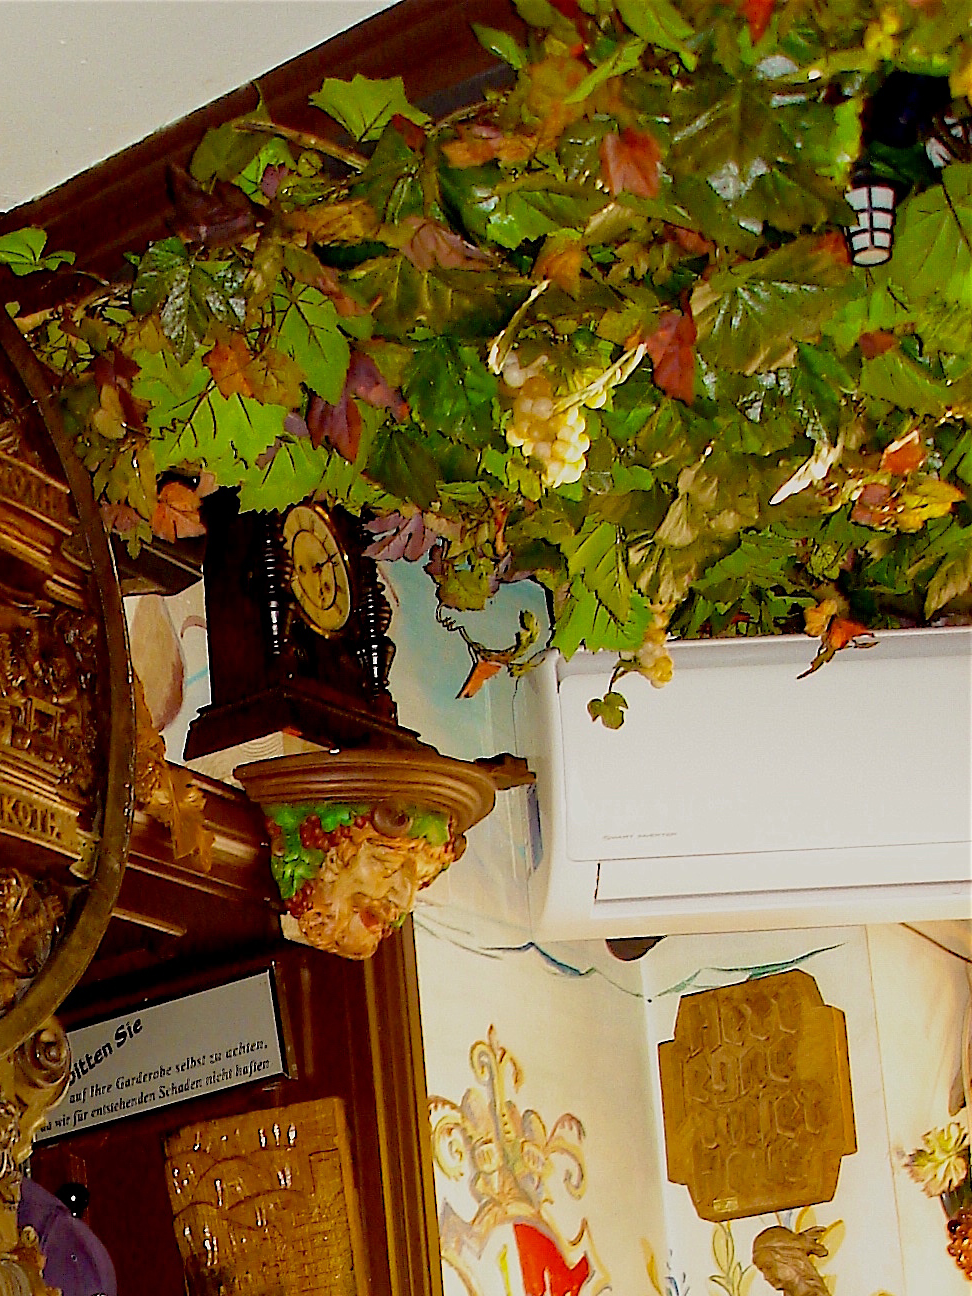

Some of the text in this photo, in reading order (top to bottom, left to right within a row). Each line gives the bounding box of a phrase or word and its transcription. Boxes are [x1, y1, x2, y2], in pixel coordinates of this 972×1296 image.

[114, 1018, 143, 1048] Sie
[54, 1113, 71, 1127] wir
[73, 1109, 89, 1127] für
[90, 1091, 156, 1118] entstehenden
[159, 1078, 203, 1099] Schaden
[205, 1068, 233, 1086] nicht
[235, 1059, 270, 1078] haften
[69, 1087, 87, 1104] auf
[90, 1083, 113, 1098] Ihre
[115, 1065, 172, 1090] Garderobe
[175, 1055, 206, 1074] selbst
[209, 1052, 222, 1065] zu
